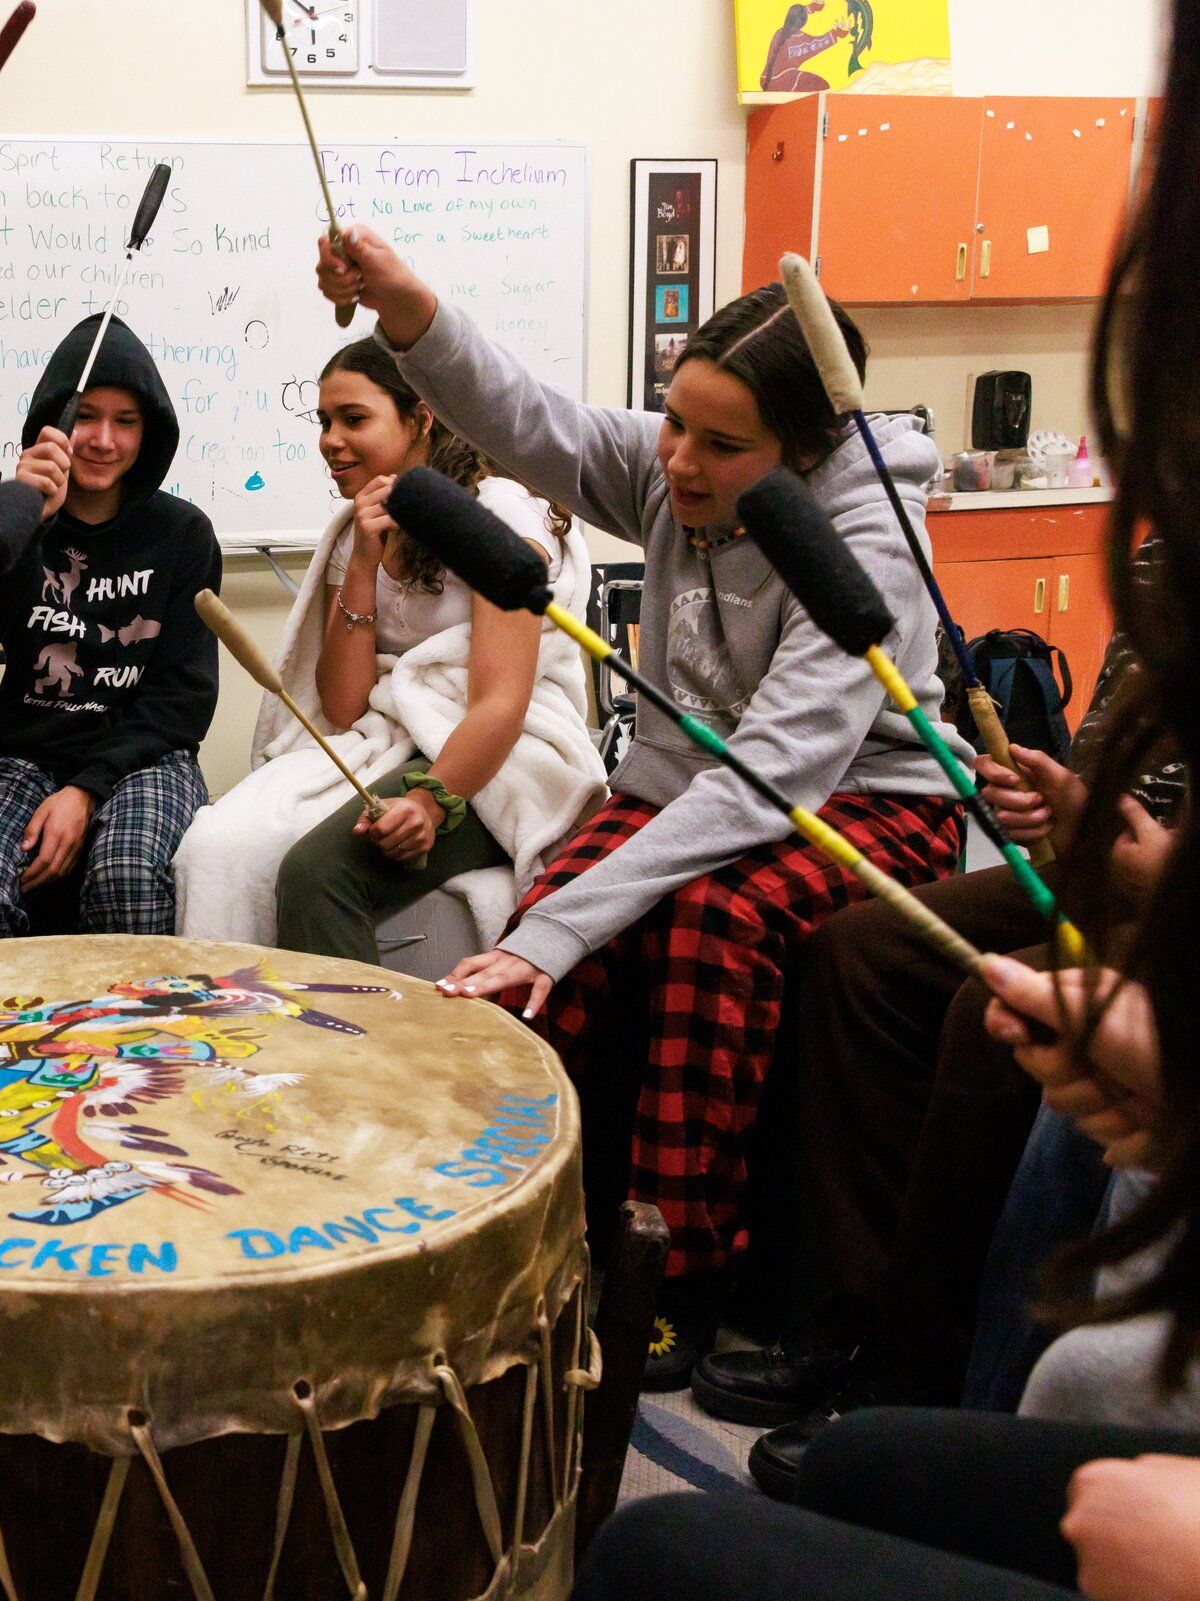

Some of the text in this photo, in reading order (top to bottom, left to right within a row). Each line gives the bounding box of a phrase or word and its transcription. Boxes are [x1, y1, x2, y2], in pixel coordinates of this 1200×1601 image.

[289, 47, 298, 57] 7
[307, 53, 317, 64] 6
[326, 48, 336, 58] 5
[375, 149, 441, 188] from
[26, 181, 89, 210] back
[99, 183, 131, 209] to
[436, 234, 447, 244] a
[26, 262, 72, 281] our
[181, 378, 220, 414] for
[272, 428, 307, 464] too
[86, 569, 155, 602] HUNT
[27, 605, 87, 639] FISH
[93, 665, 145, 689] RUN
[225, 1197, 458, 1260] DANCE
[432, 1093, 559, 1189] SPECIAL
